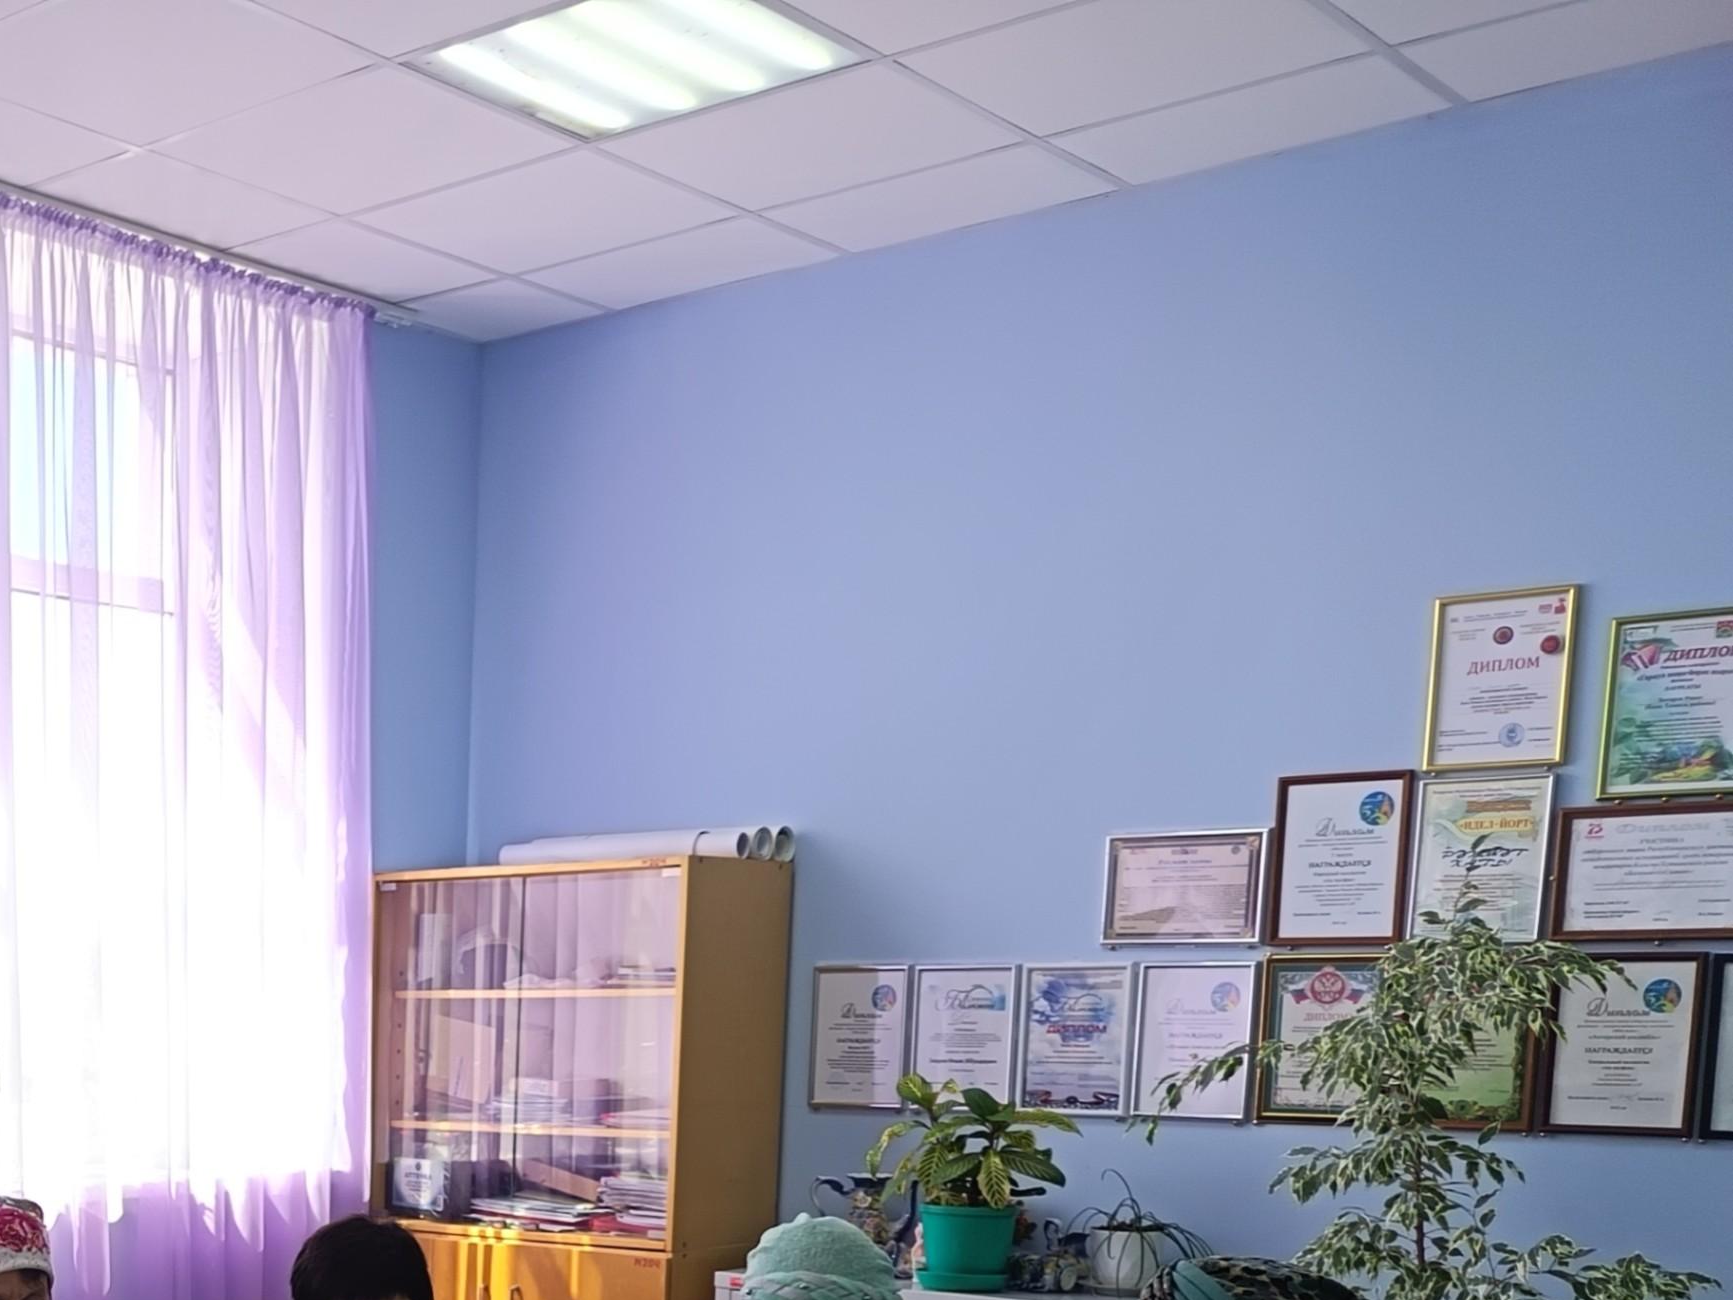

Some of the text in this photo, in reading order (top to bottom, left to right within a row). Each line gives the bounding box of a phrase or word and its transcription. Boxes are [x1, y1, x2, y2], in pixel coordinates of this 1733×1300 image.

[1663, 645, 1733, 663] ДИПЛО
[1467, 656, 1540, 676] ДИПЛОМ
[1046, 1024, 1108, 1034] ДИПЛОМ
